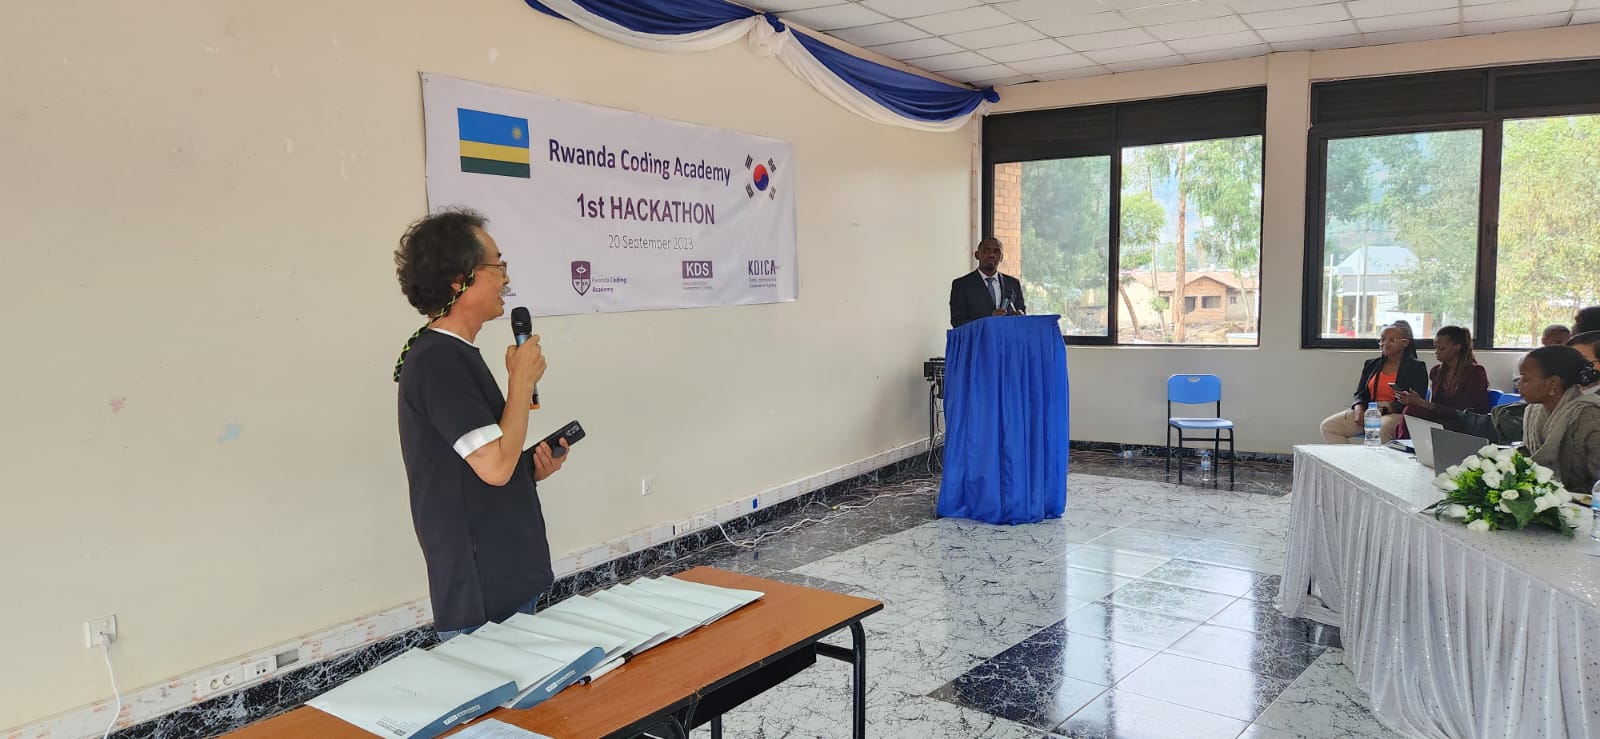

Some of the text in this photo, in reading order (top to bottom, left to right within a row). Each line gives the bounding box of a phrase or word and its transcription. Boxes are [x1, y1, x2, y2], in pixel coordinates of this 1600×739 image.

[549, 138, 731, 187] Rwanda Coding Academy
[576, 193, 715, 225] 1st HACKATHON
[608, 234, 694, 252] 20 September 2023
[686, 261, 710, 277] KDS
[747, 259, 776, 276] KOICA
